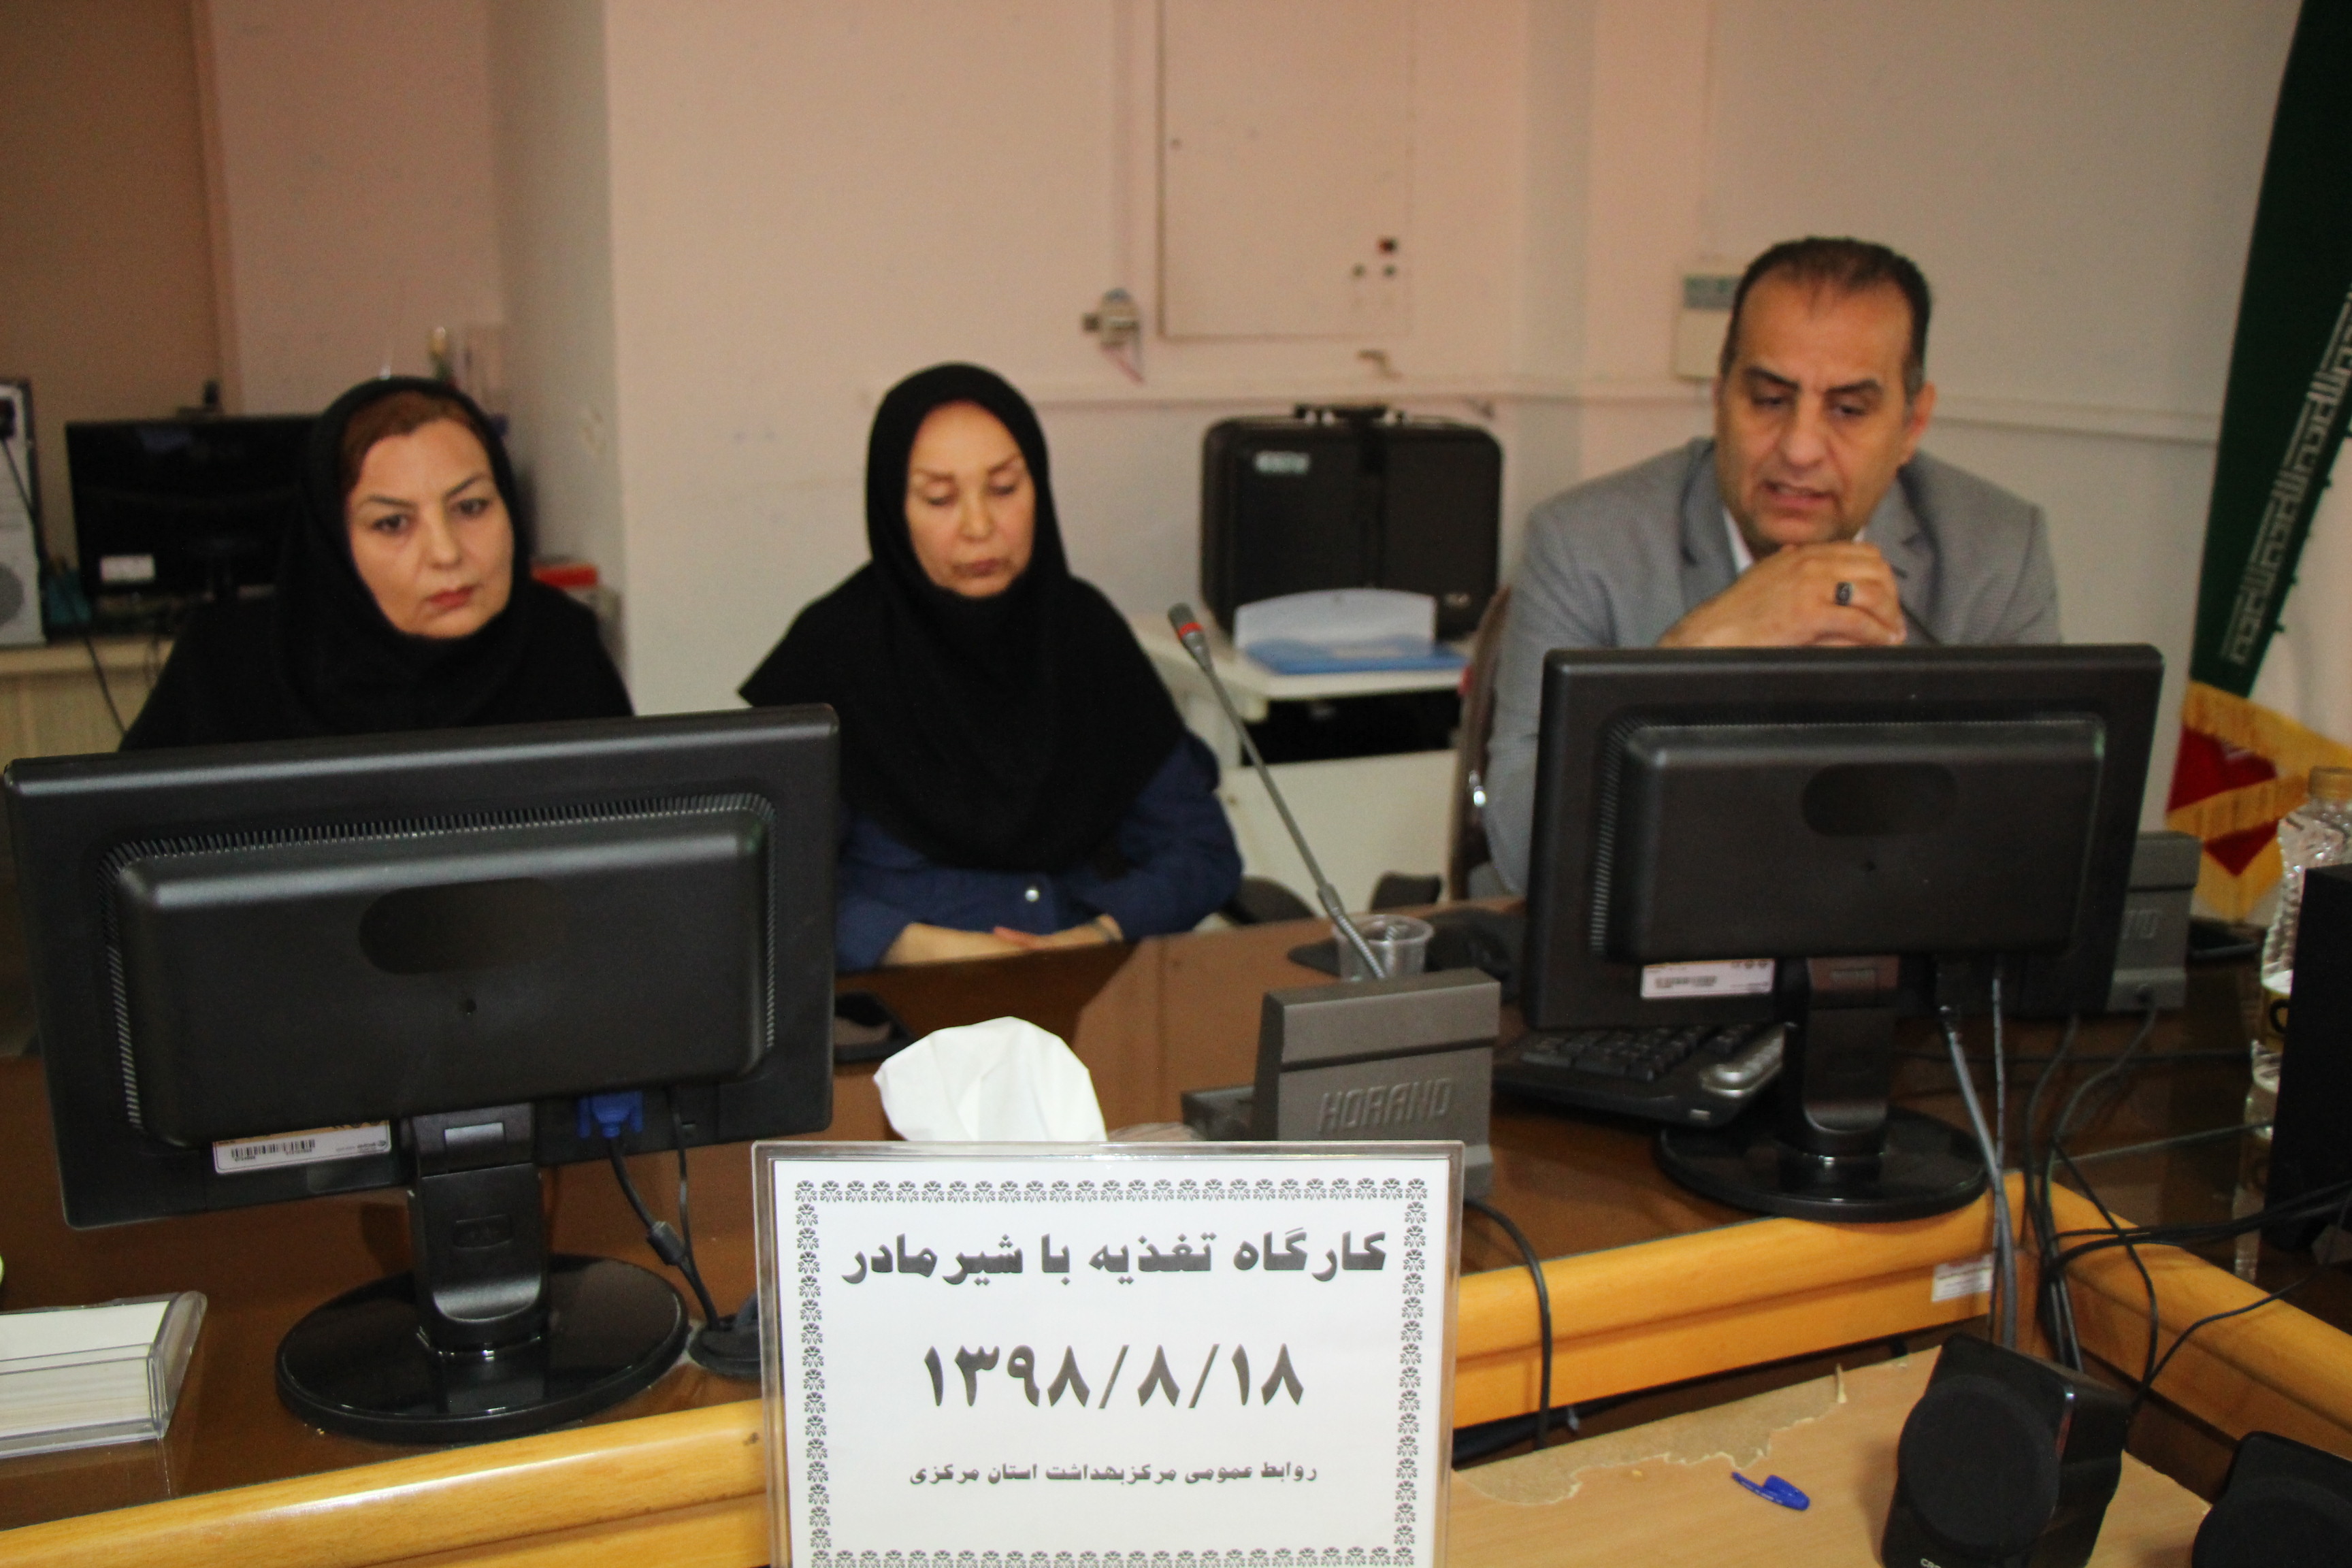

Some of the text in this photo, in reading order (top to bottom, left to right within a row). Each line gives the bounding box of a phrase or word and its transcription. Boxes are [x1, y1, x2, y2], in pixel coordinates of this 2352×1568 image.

[1041, 1233, 1071, 1286] با
[1088, 1231, 1218, 1286] تغذیه
[1233, 1227, 1387, 1283] کارگاه
[909, 1463, 980, 1485] مرکزی
[987, 1463, 1038, 1485] استان
[1184, 1465, 1253, 1485] عمومی
[1260, 1461, 1318, 1482] روابط
